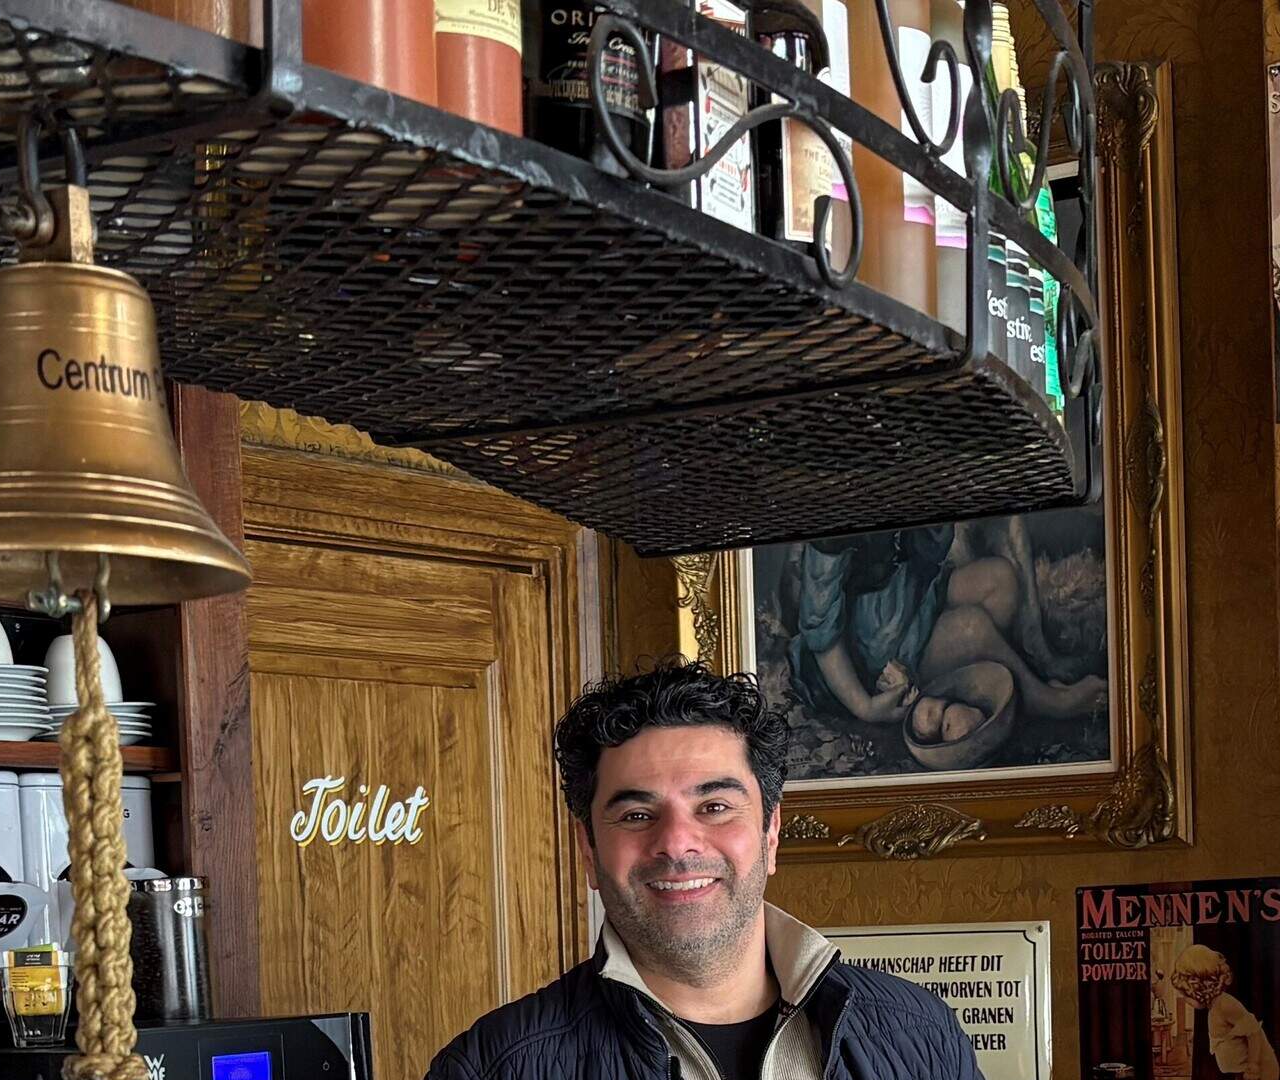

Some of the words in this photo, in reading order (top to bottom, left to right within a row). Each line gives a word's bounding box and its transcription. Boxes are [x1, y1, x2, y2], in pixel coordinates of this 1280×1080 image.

[37, 348, 151, 402] Centrum
[290, 775, 428, 845] Toilet
[1081, 942, 1146, 961] TOILET
[938, 954, 978, 973] HEEFT
[980, 954, 1004, 973] DIT
[1082, 963, 1148, 983] POWDER
[995, 980, 1022, 998] TOT
[962, 1006, 1014, 1025] GRANEN
